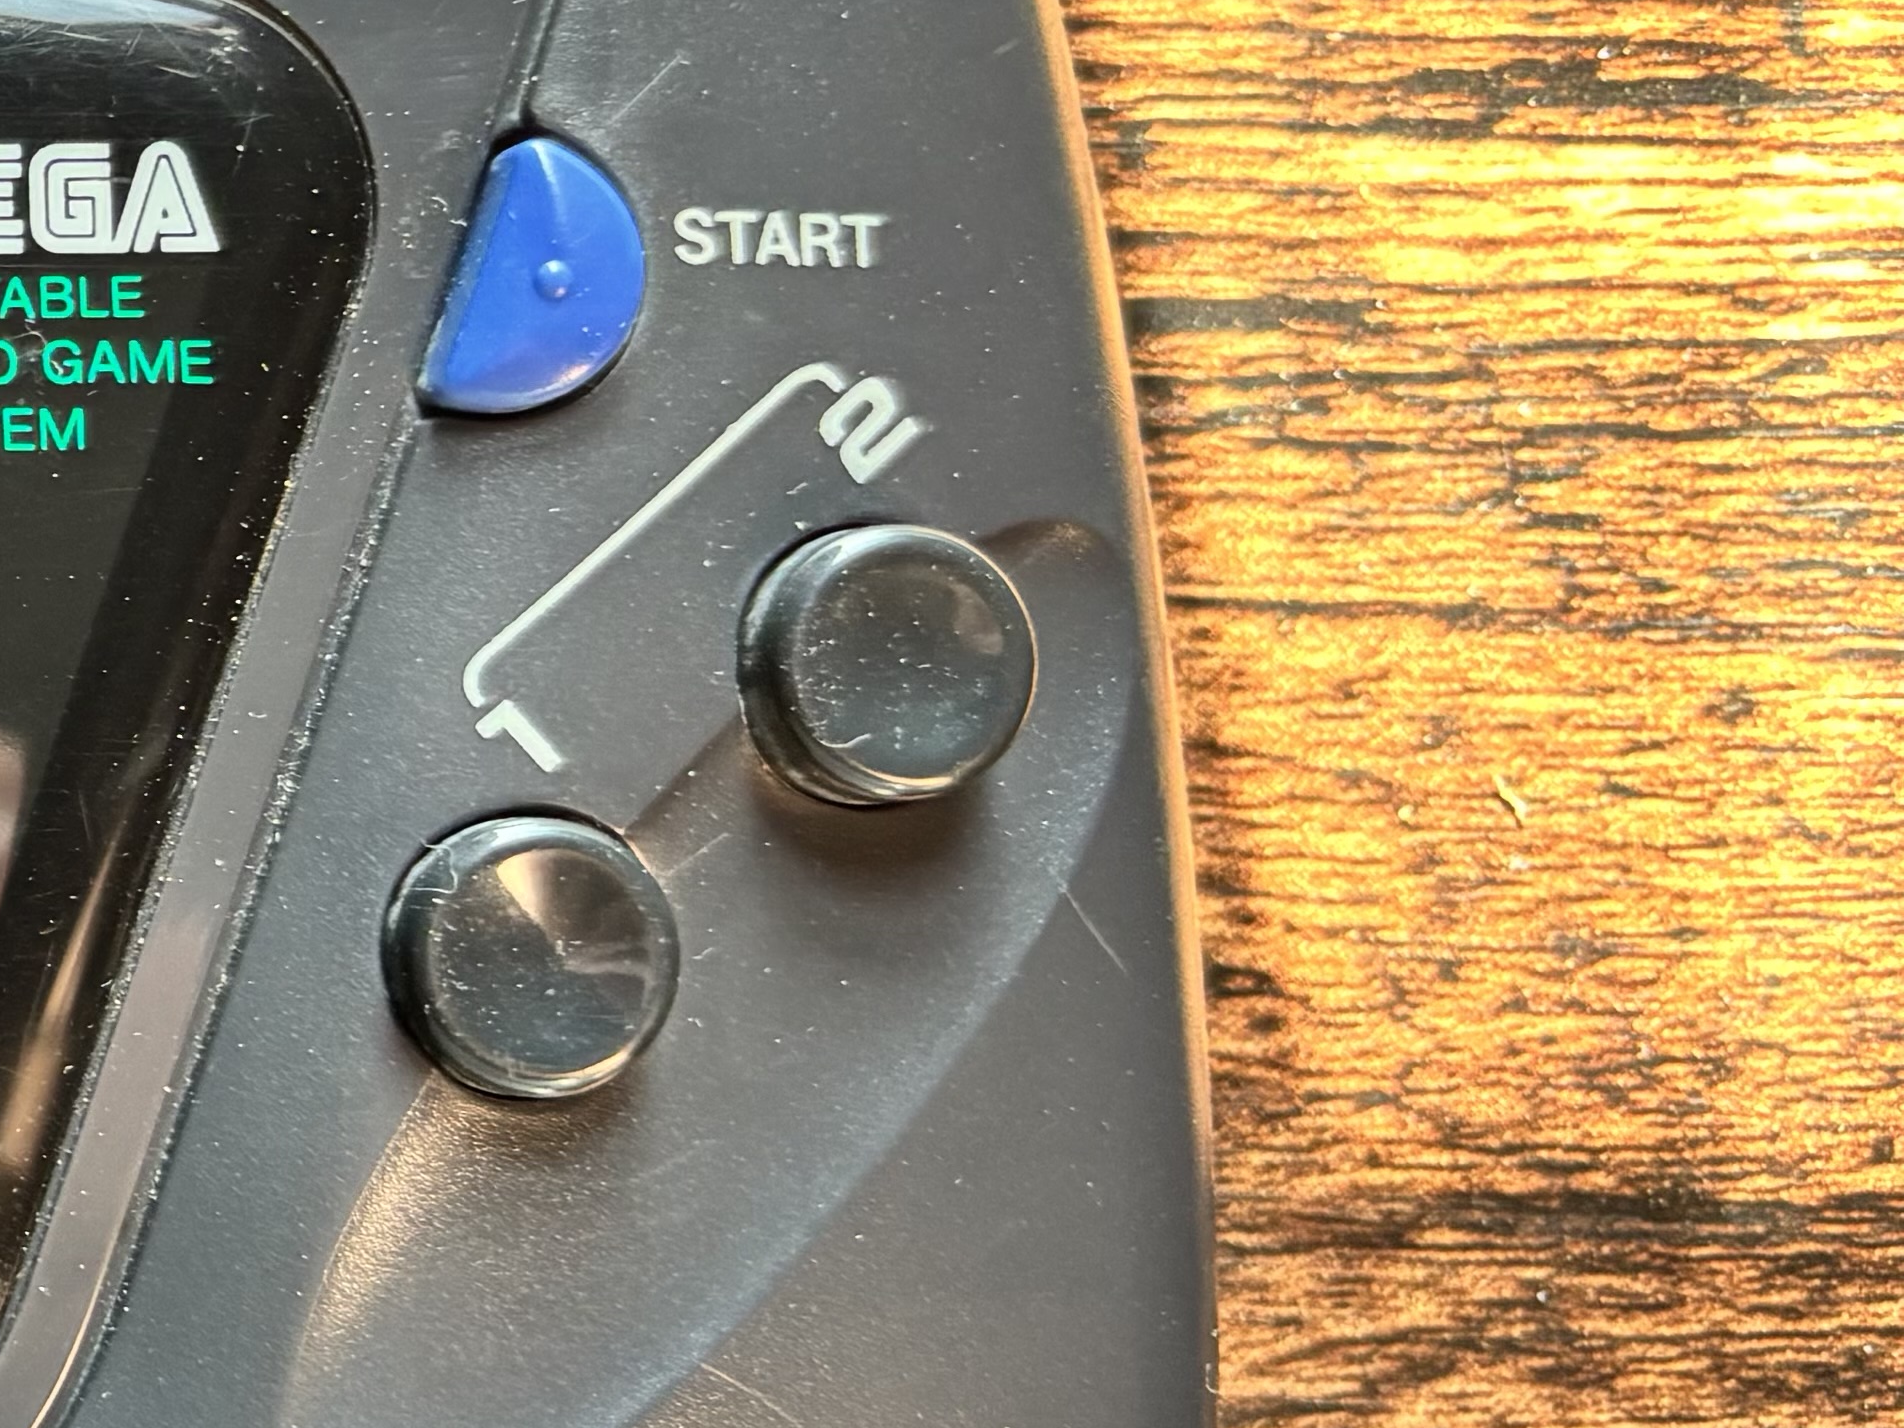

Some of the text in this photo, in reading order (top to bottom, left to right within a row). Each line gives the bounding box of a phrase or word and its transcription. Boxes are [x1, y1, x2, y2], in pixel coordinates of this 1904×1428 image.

[673, 208, 886, 268] START
[41, 339, 214, 385] GAME
[819, 376, 925, 484] 2
[475, 700, 563, 772] 1
